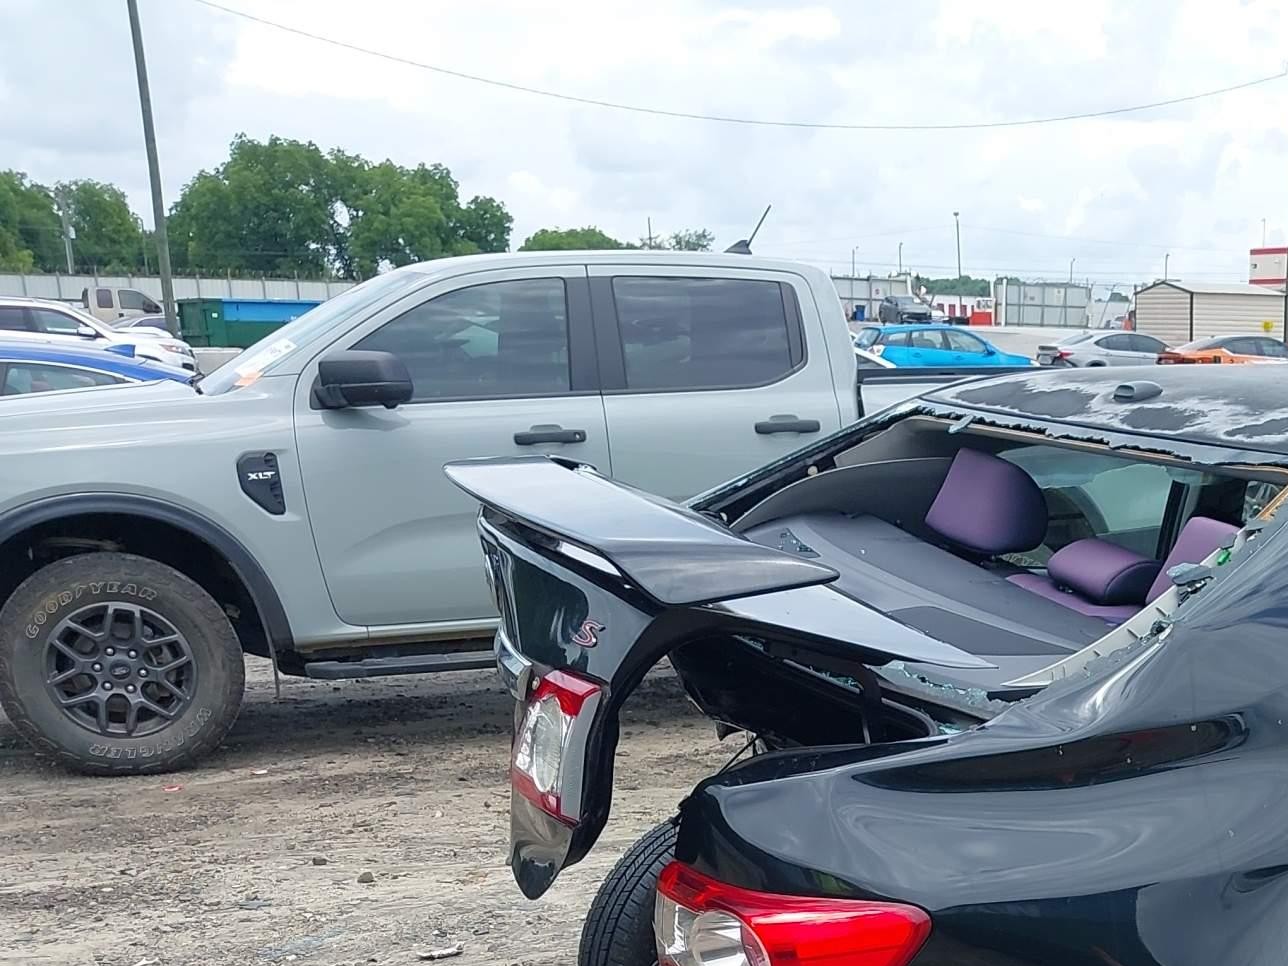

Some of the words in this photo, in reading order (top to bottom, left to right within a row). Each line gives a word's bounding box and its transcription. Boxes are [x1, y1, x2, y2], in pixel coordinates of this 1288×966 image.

[247, 471, 276, 481] XLT
[24, 580, 160, 641] GOODYEAR
[572, 619, 606, 648] S
[88, 706, 213, 759] WRANGLER
